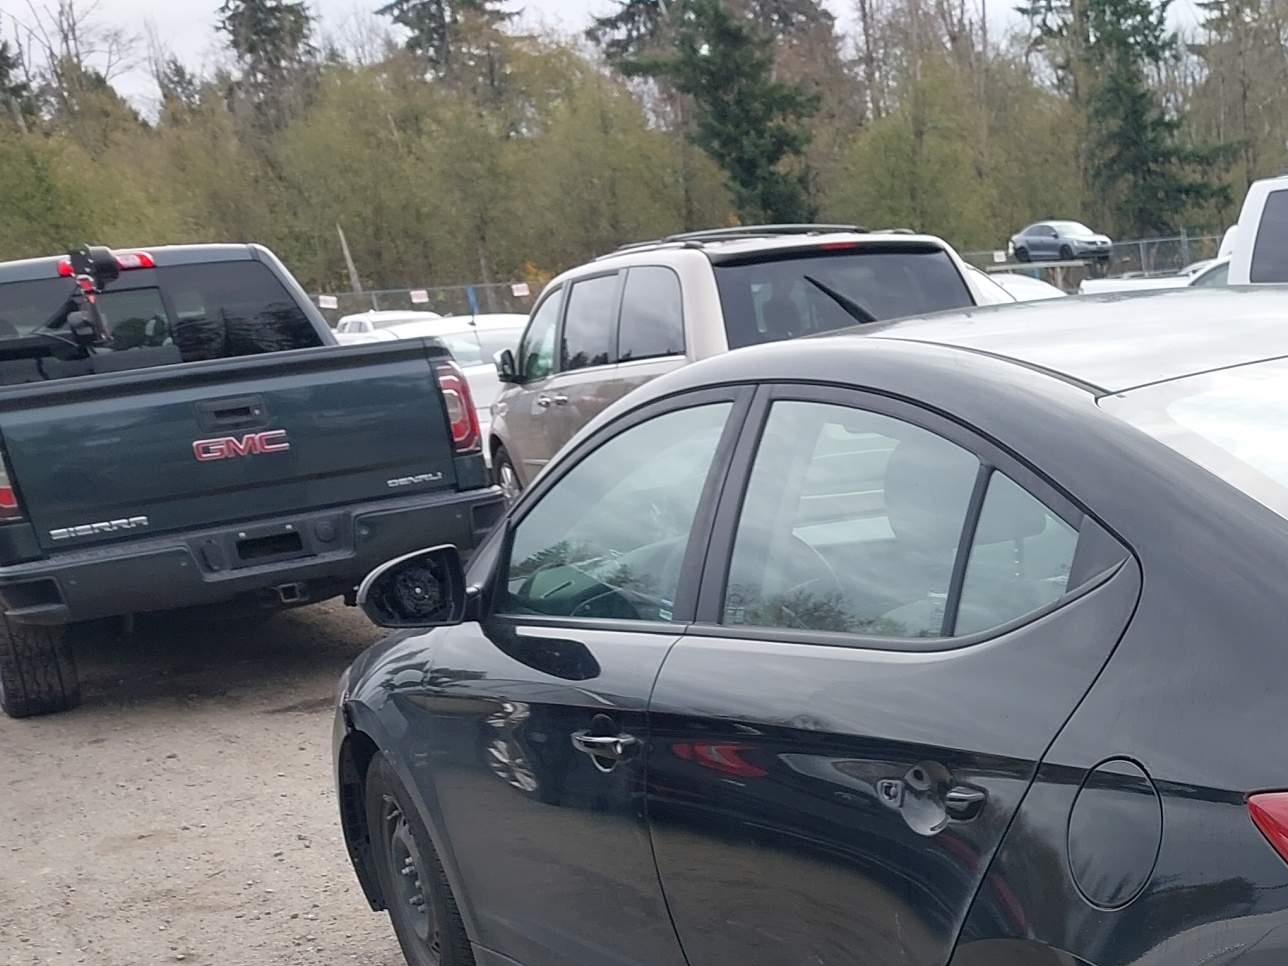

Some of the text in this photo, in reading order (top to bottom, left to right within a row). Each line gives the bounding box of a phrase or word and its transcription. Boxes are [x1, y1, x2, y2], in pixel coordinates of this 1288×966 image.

[191, 429, 291, 462] GMC
[386, 471, 443, 488] DENALI
[48, 515, 150, 541] SIERRA
